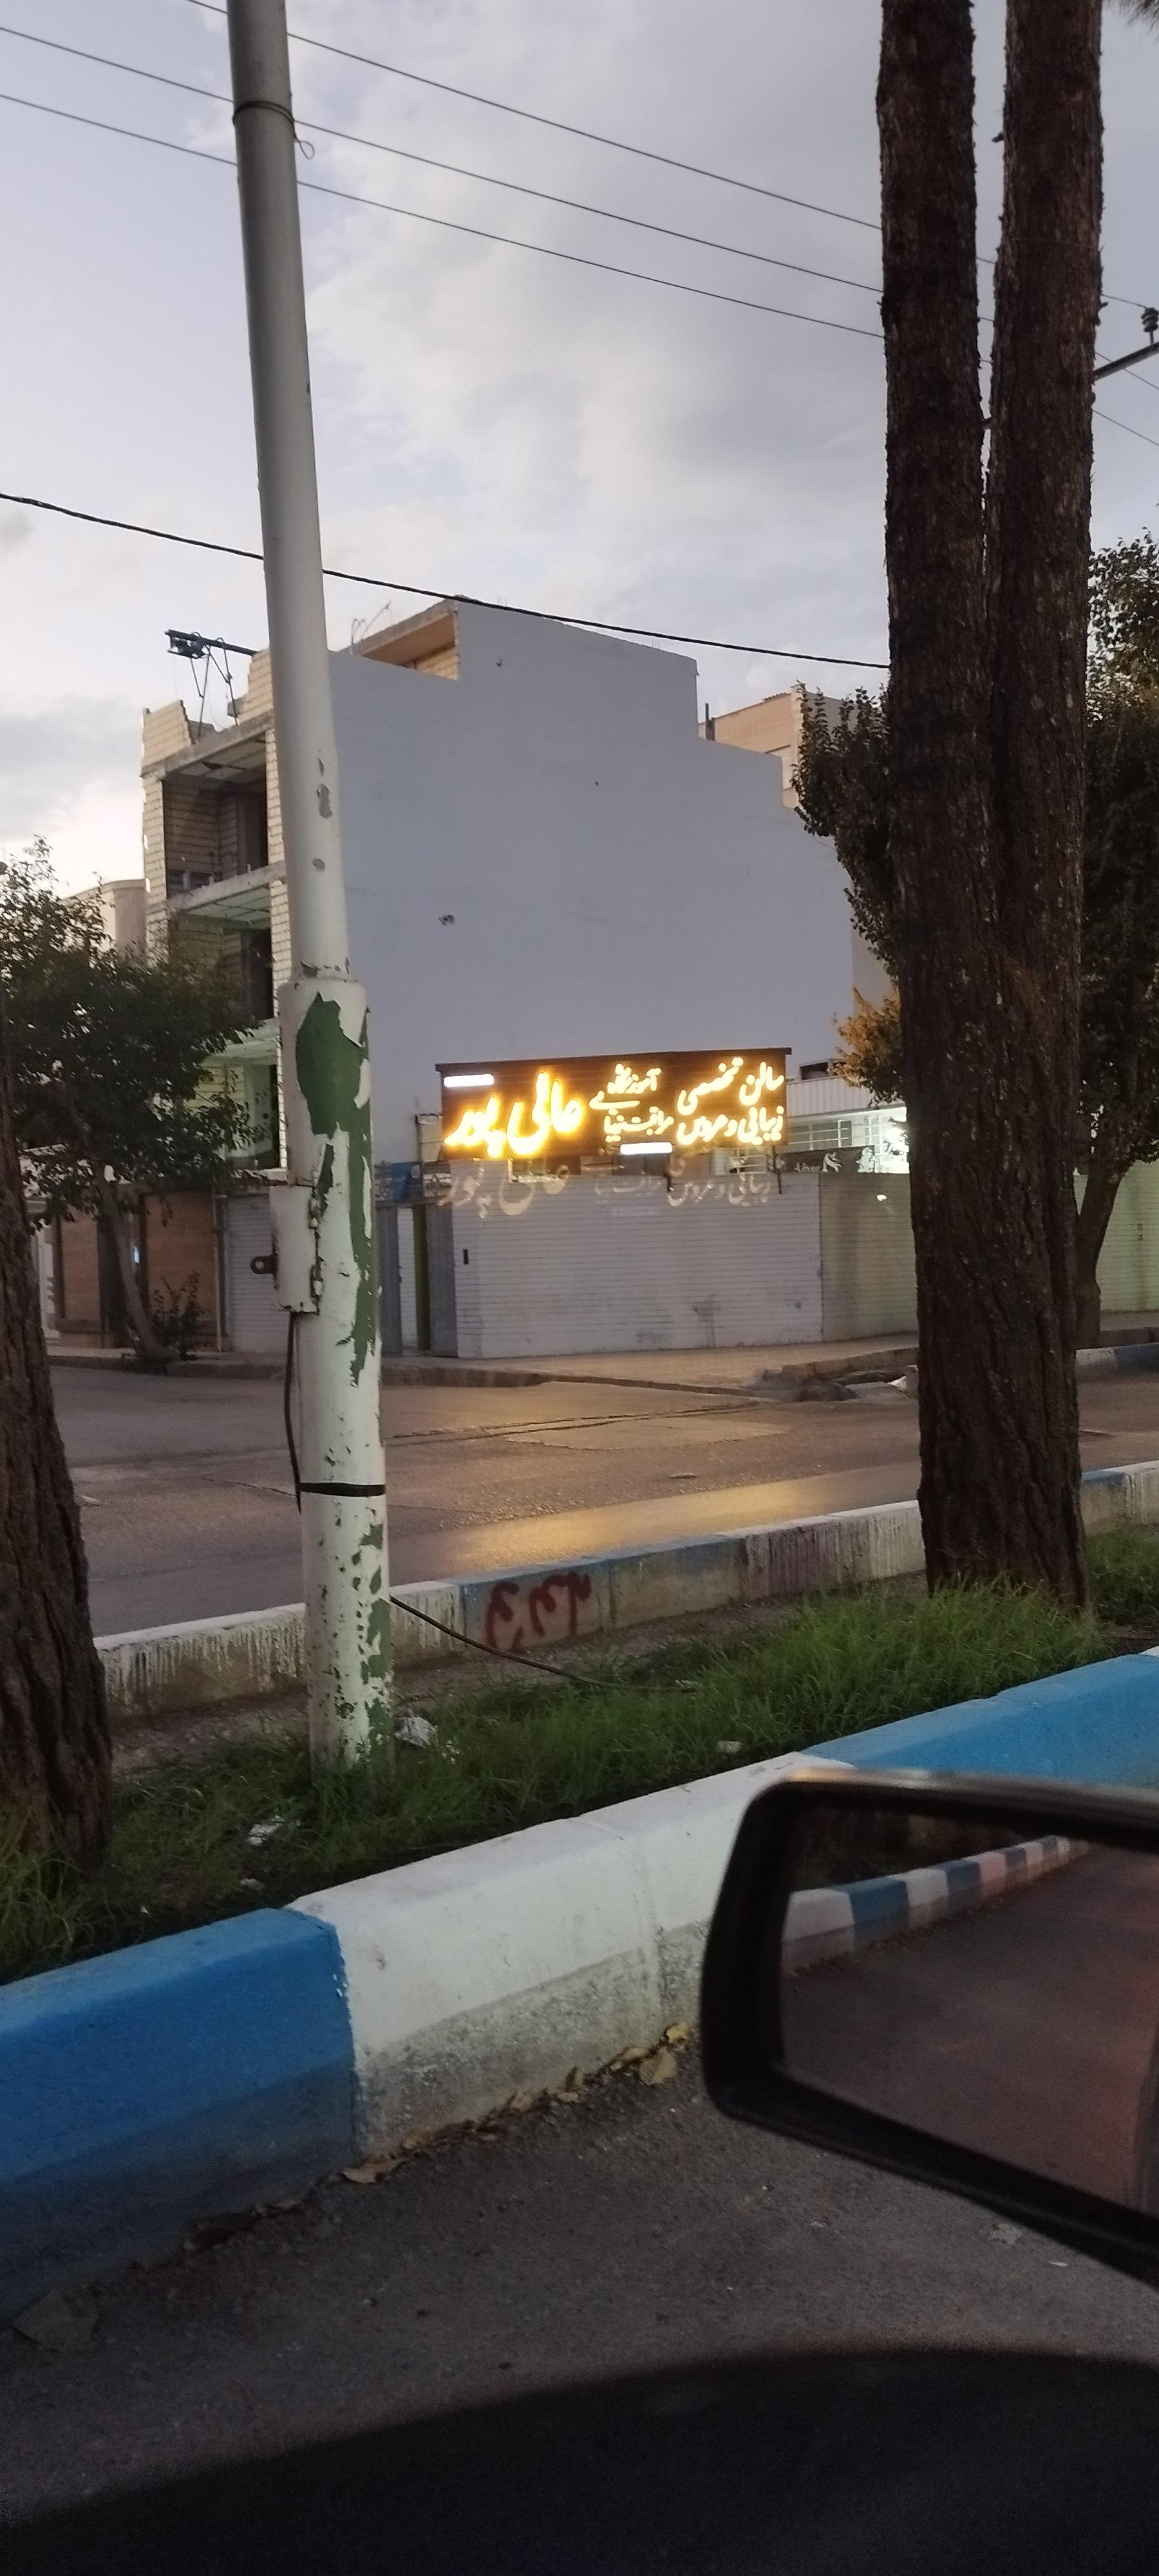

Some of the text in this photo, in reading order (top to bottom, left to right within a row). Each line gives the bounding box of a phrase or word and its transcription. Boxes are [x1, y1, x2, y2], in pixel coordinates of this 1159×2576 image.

[677, 1057, 784, 1115] سالن تخصصی
[444, 1072, 586, 1159] عالی پور
[622, 1106, 675, 1135] مراقبت
[676, 1105, 784, 1146] زیبایی و عروس
